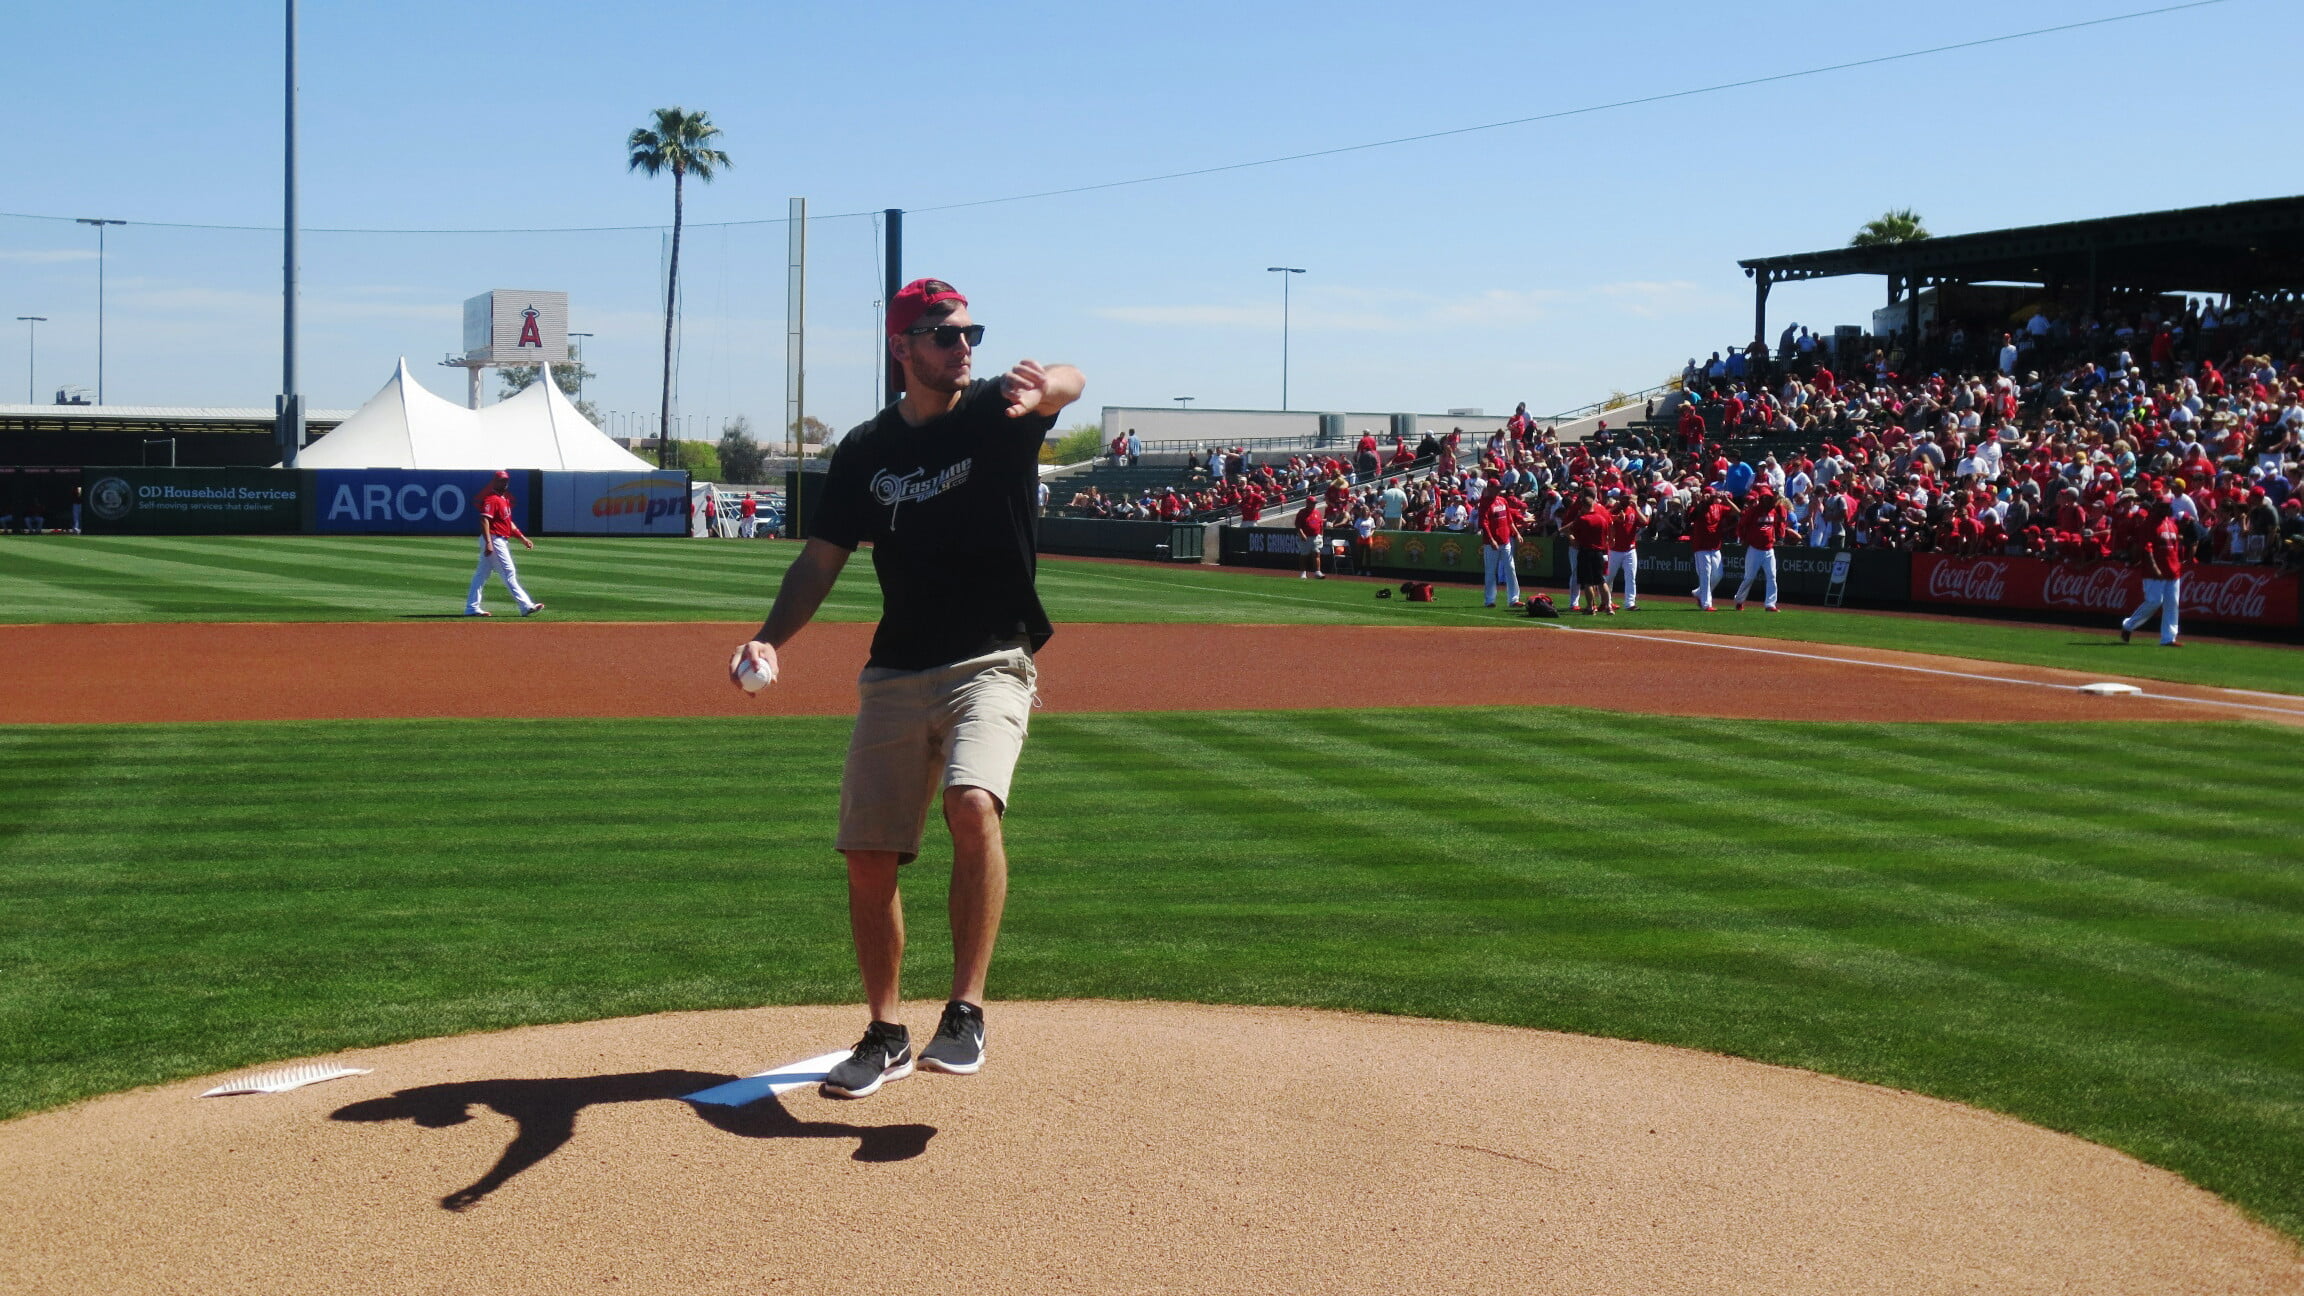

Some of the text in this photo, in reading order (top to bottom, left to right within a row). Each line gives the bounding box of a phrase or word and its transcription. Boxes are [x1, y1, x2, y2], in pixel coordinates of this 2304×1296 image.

[518, 304, 542, 347] A
[138, 486, 297, 500] OD Household Services
[190, 503, 223, 511] services
[224, 502, 241, 511] that
[328, 484, 466, 521] ARCO
[1249, 533, 1264, 552] DOS
[1673, 556, 1691, 572] Inn
[1722, 556, 1744, 568] CHEC
[1782, 559, 1833, 573] CHECK OU
[1929, 559, 2008, 600] Coca-Cola
[2043, 565, 2133, 608] Coca-Cola
